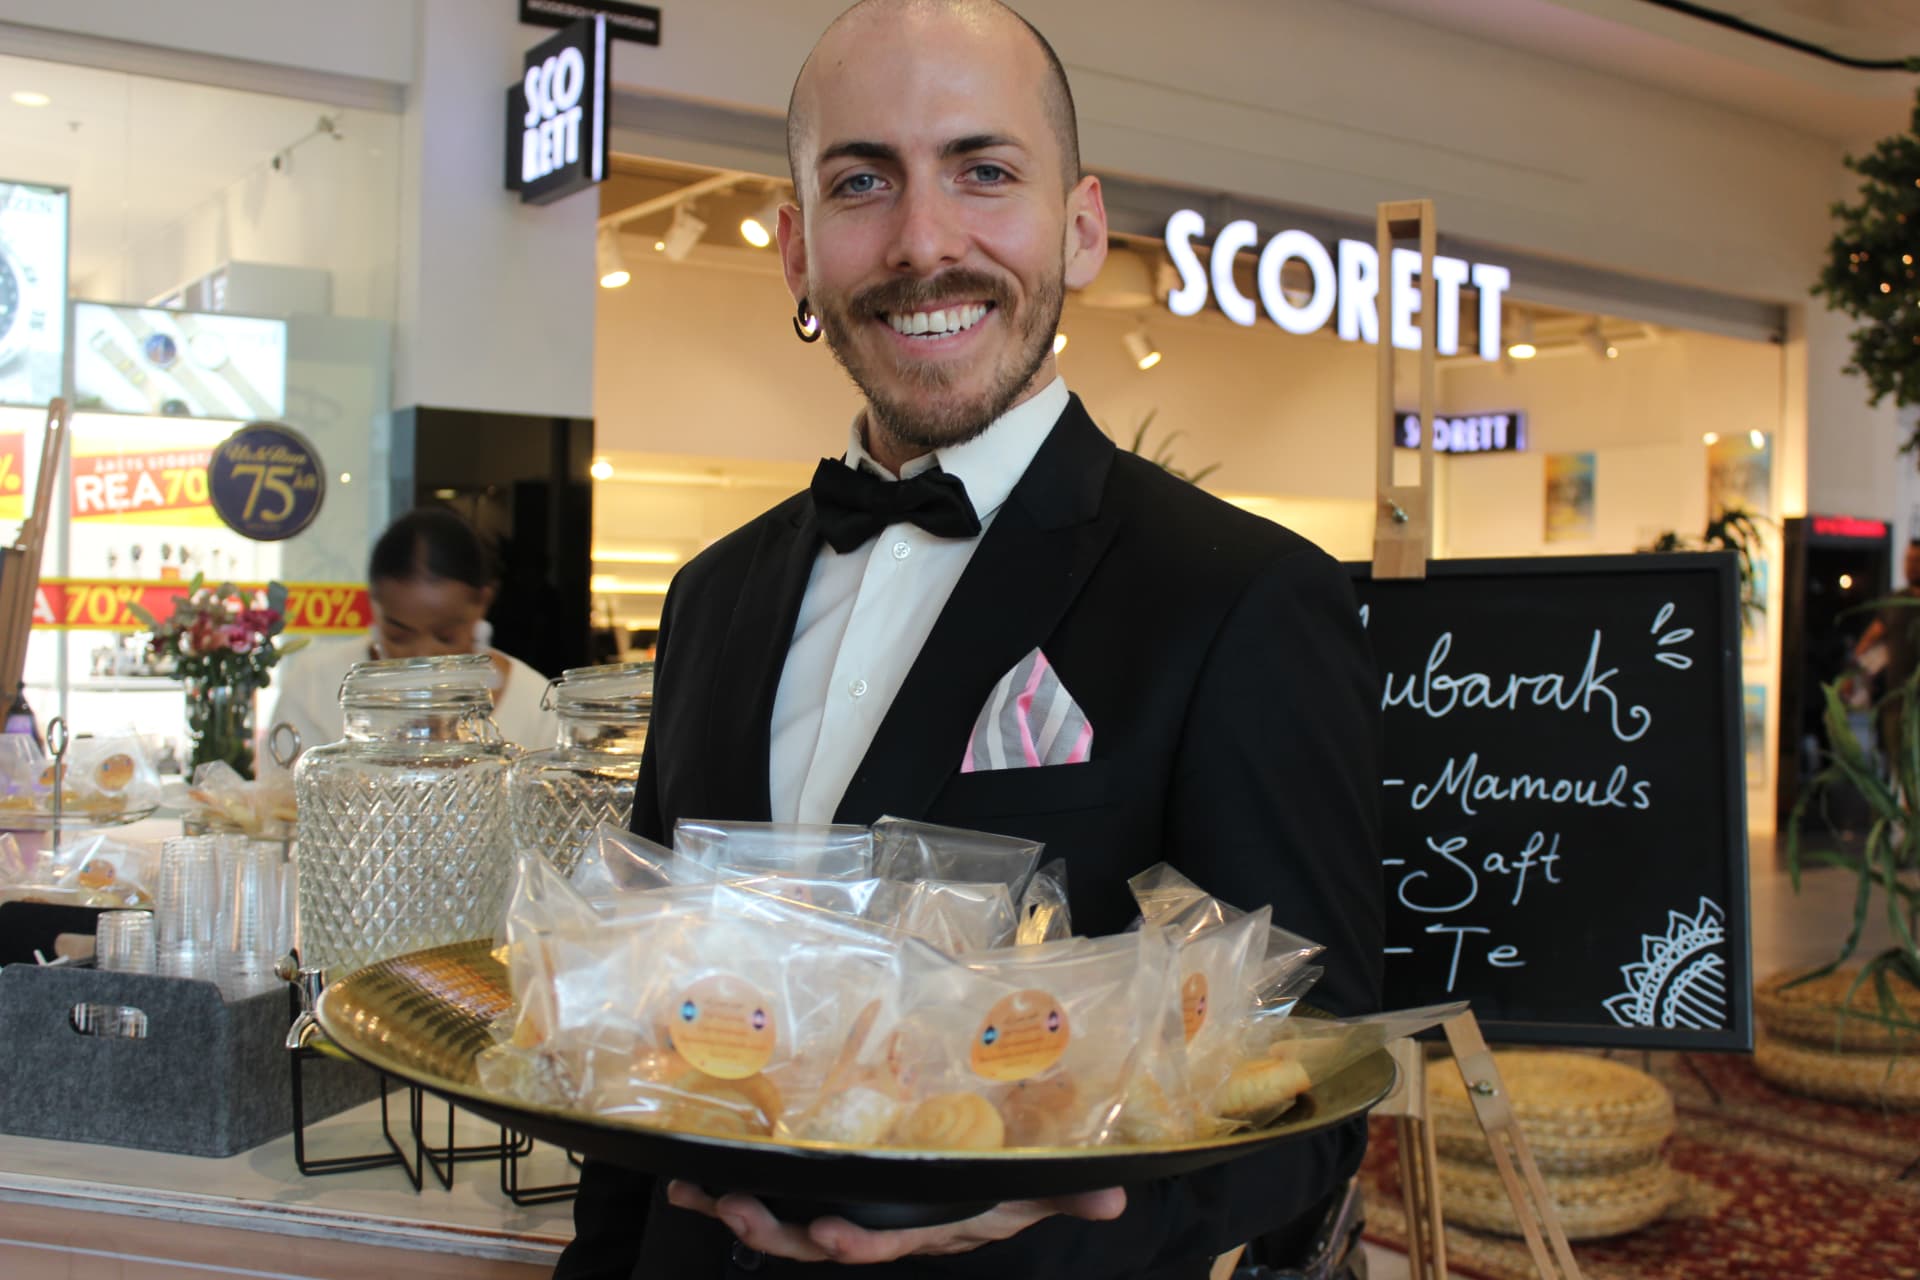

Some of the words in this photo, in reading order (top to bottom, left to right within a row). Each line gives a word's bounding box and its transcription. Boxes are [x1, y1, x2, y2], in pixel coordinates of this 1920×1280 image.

[524, 46, 584, 128] SCO
[1165, 208, 1510, 362] SCORETT
[1404, 415, 1509, 452] SORETT
[230, 464, 296, 521] 75
[65, 585, 145, 624] 70%
[285, 590, 361, 626] 70%
[1381, 629, 1651, 741] ubarak
[1411, 752, 1651, 816] Mamouls
[1398, 831, 1561, 913] Saft
[1424, 923, 1526, 993] Te
